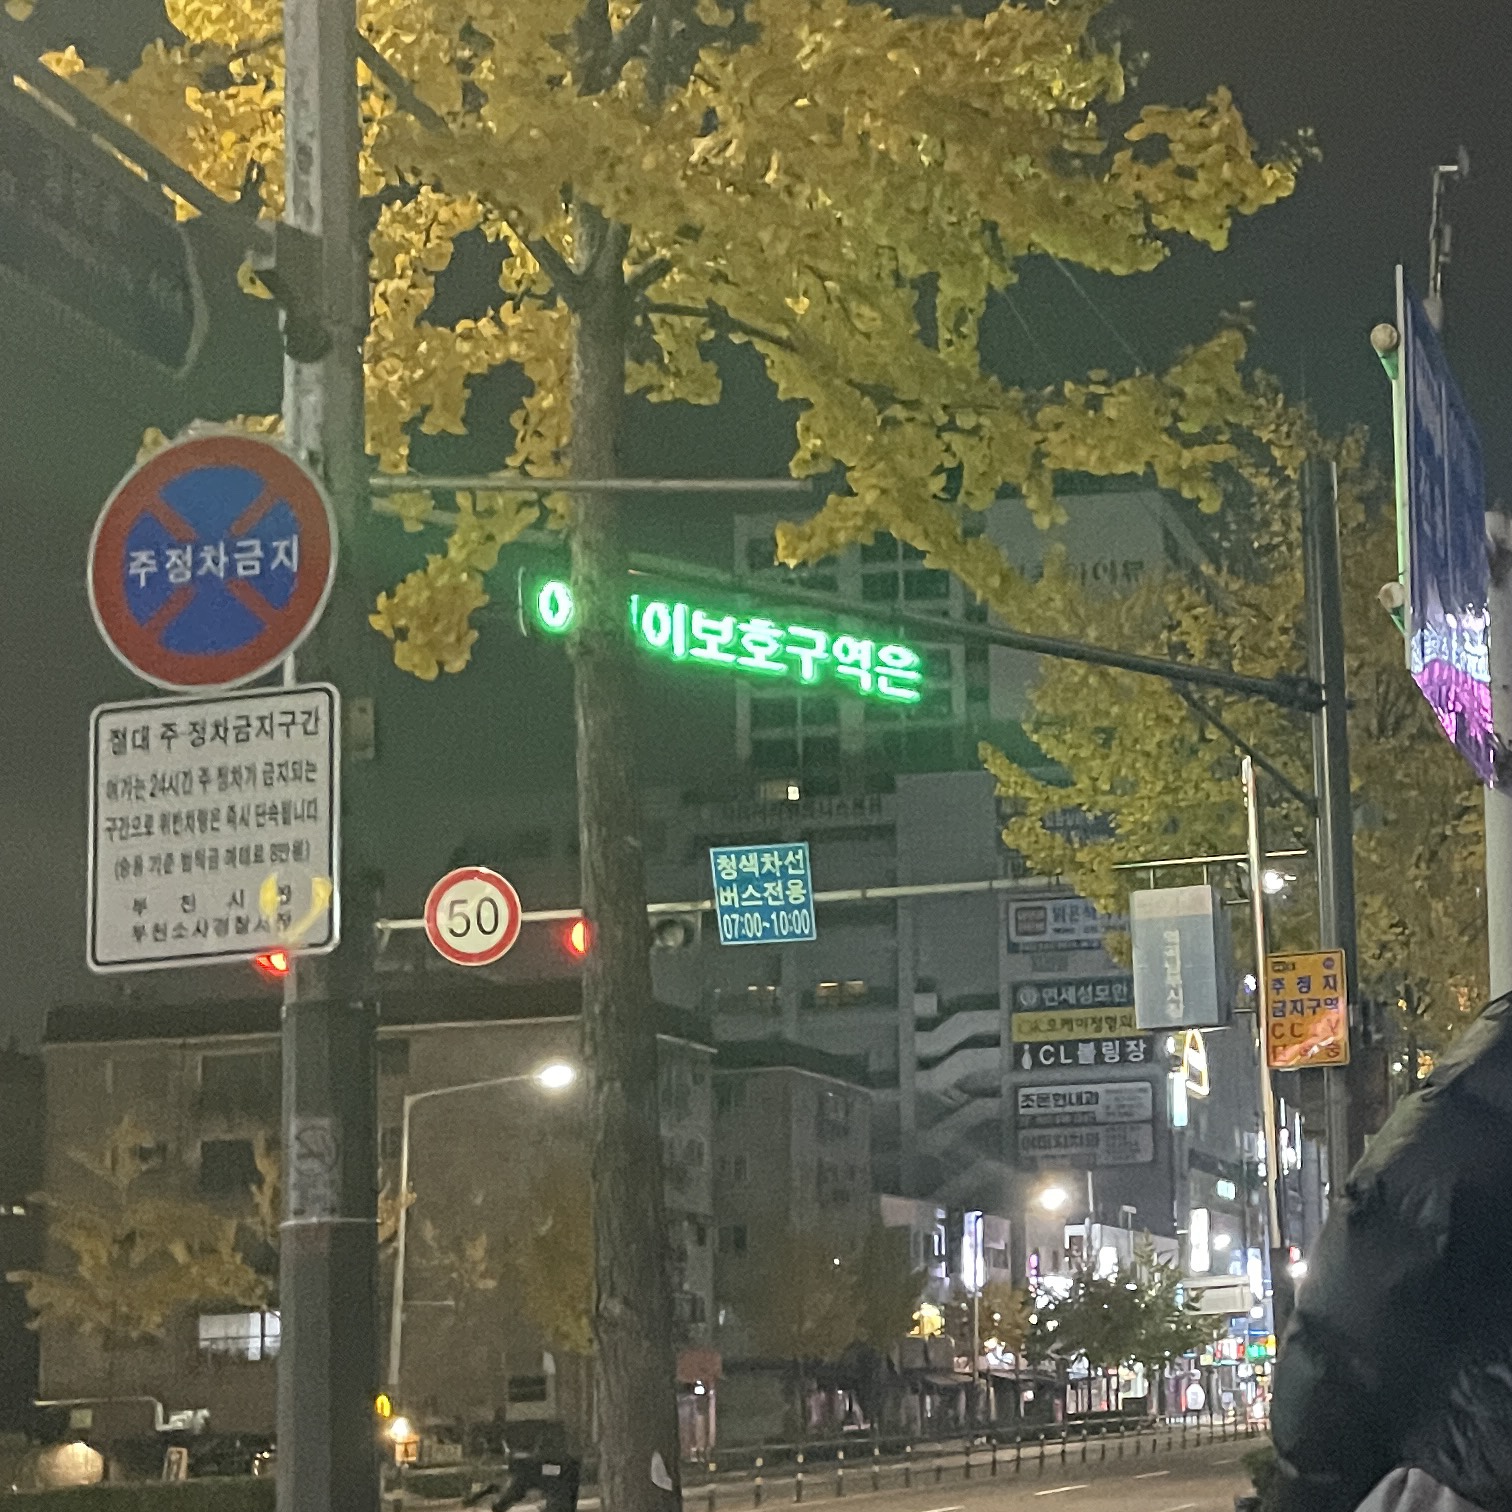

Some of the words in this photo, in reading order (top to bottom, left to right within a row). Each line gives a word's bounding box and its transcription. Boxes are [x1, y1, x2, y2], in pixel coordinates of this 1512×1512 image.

[128, 534, 299, 588] 주정차금지
[109, 725, 151, 756] 절대
[150, 770, 193, 799] 24시간
[717, 849, 805, 879] 청색차선
[719, 879, 807, 908] 버스전용
[447, 896, 500, 938] 50
[722, 907, 811, 941] 07:00~10:00
[1272, 996, 1339, 1018] 금지구역
